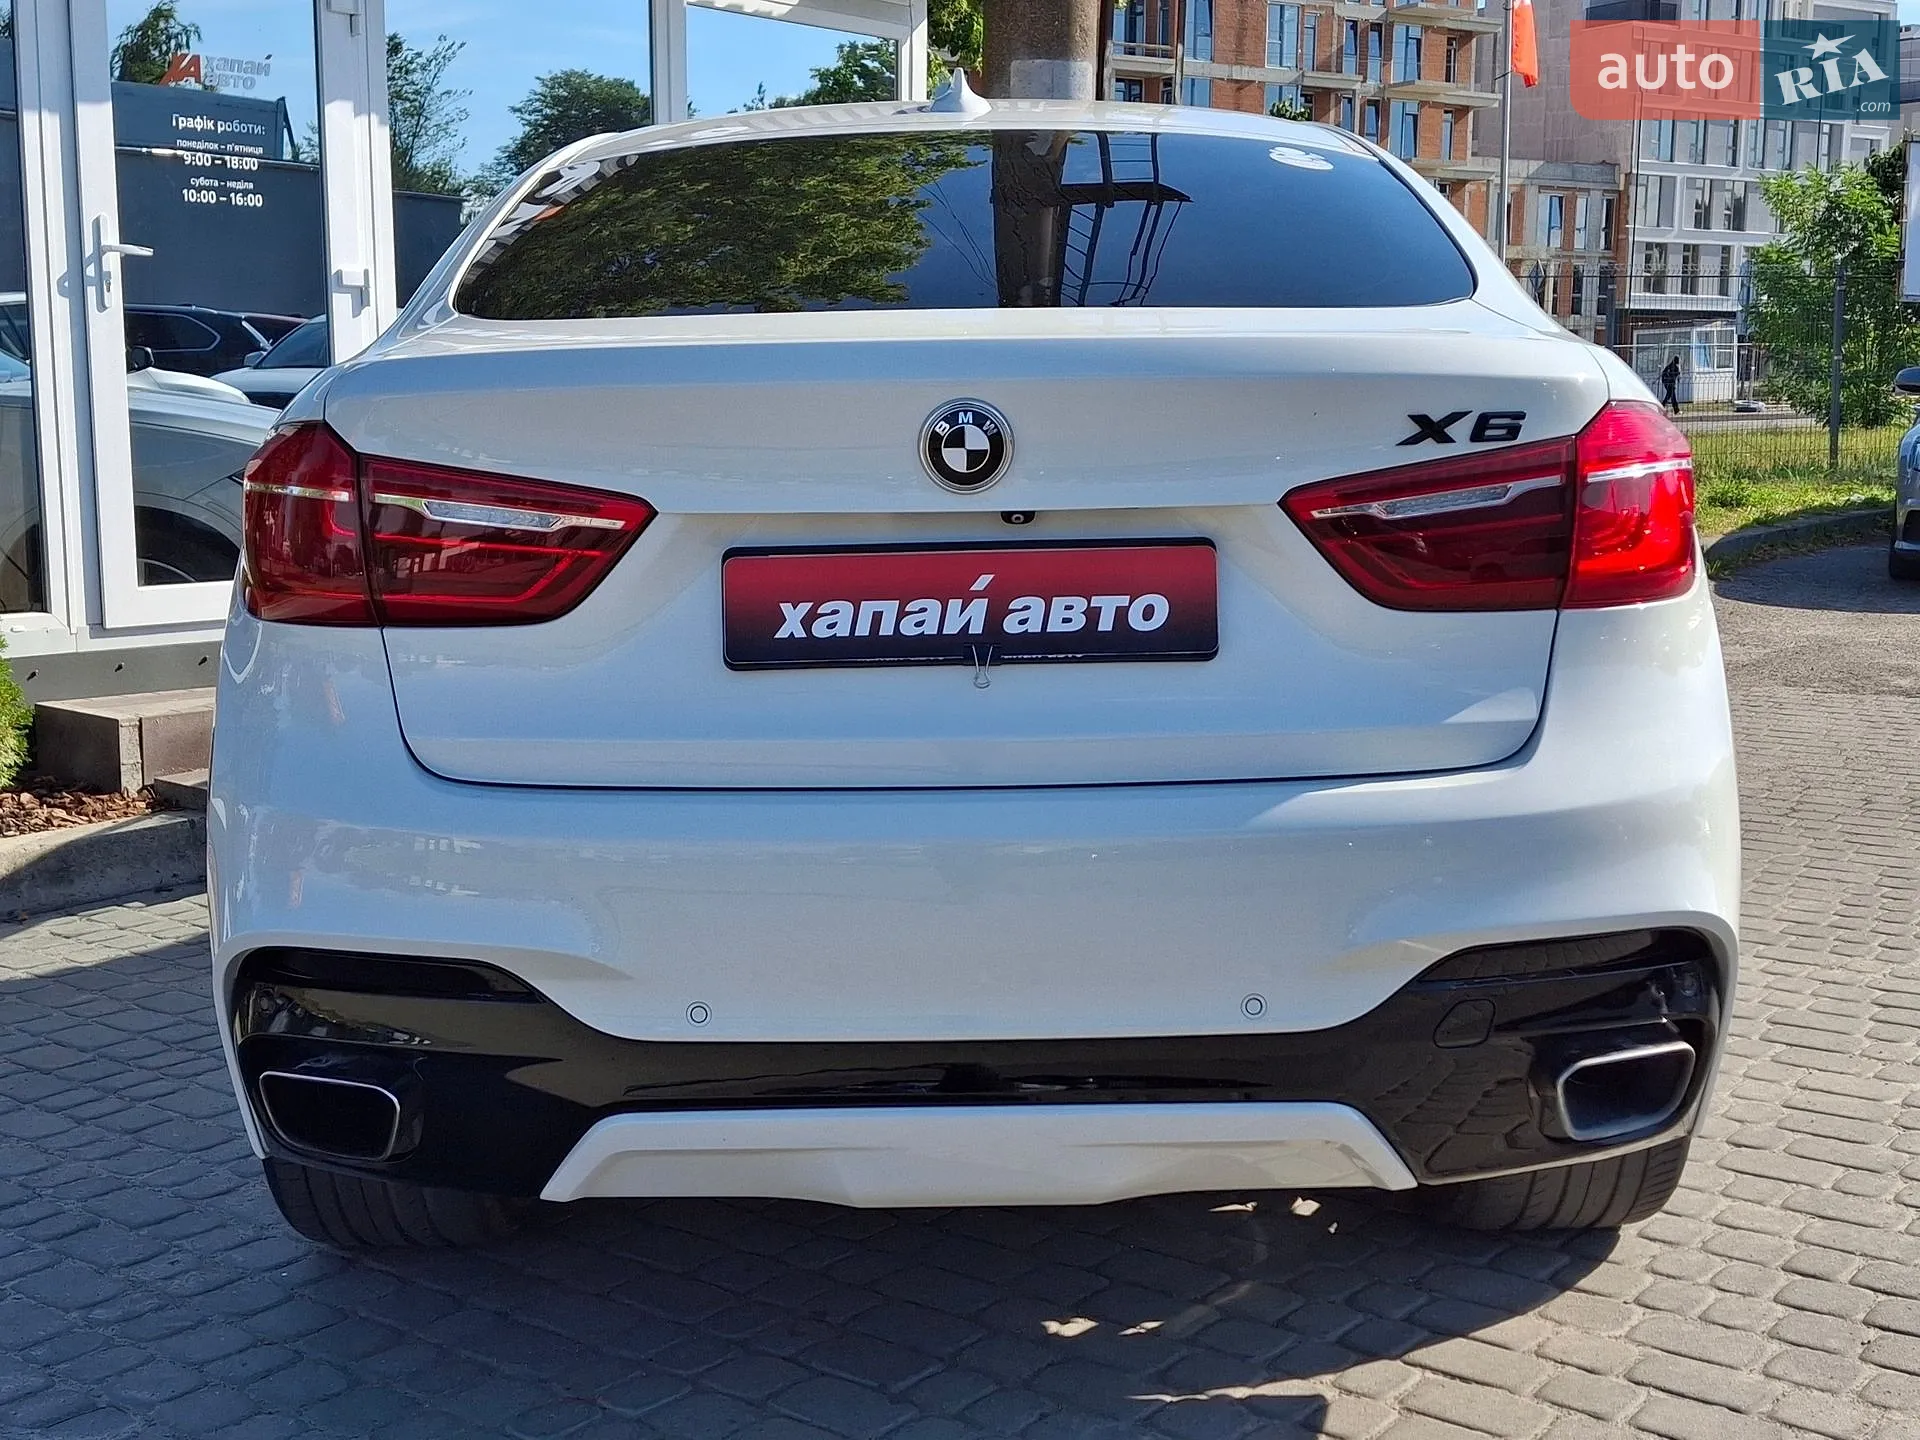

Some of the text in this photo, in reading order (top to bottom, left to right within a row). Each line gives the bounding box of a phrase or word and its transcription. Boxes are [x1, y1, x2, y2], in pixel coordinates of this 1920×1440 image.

[204, 72, 256, 90] авто
[171, 114, 266, 135] Графік роботи:
[176, 139, 219, 151] понеділок
[183, 152, 212, 166] 9:00
[225, 157, 259, 171] 18:00
[190, 177, 219, 188] субота
[226, 180, 254, 190] неділя
[182, 189, 217, 204] 10:00
[229, 193, 264, 207] 16:00
[935, 411, 998, 437] BMW
[1395, 410, 1527, 446] X6
[774, 573, 1170, 639] хапай авто
